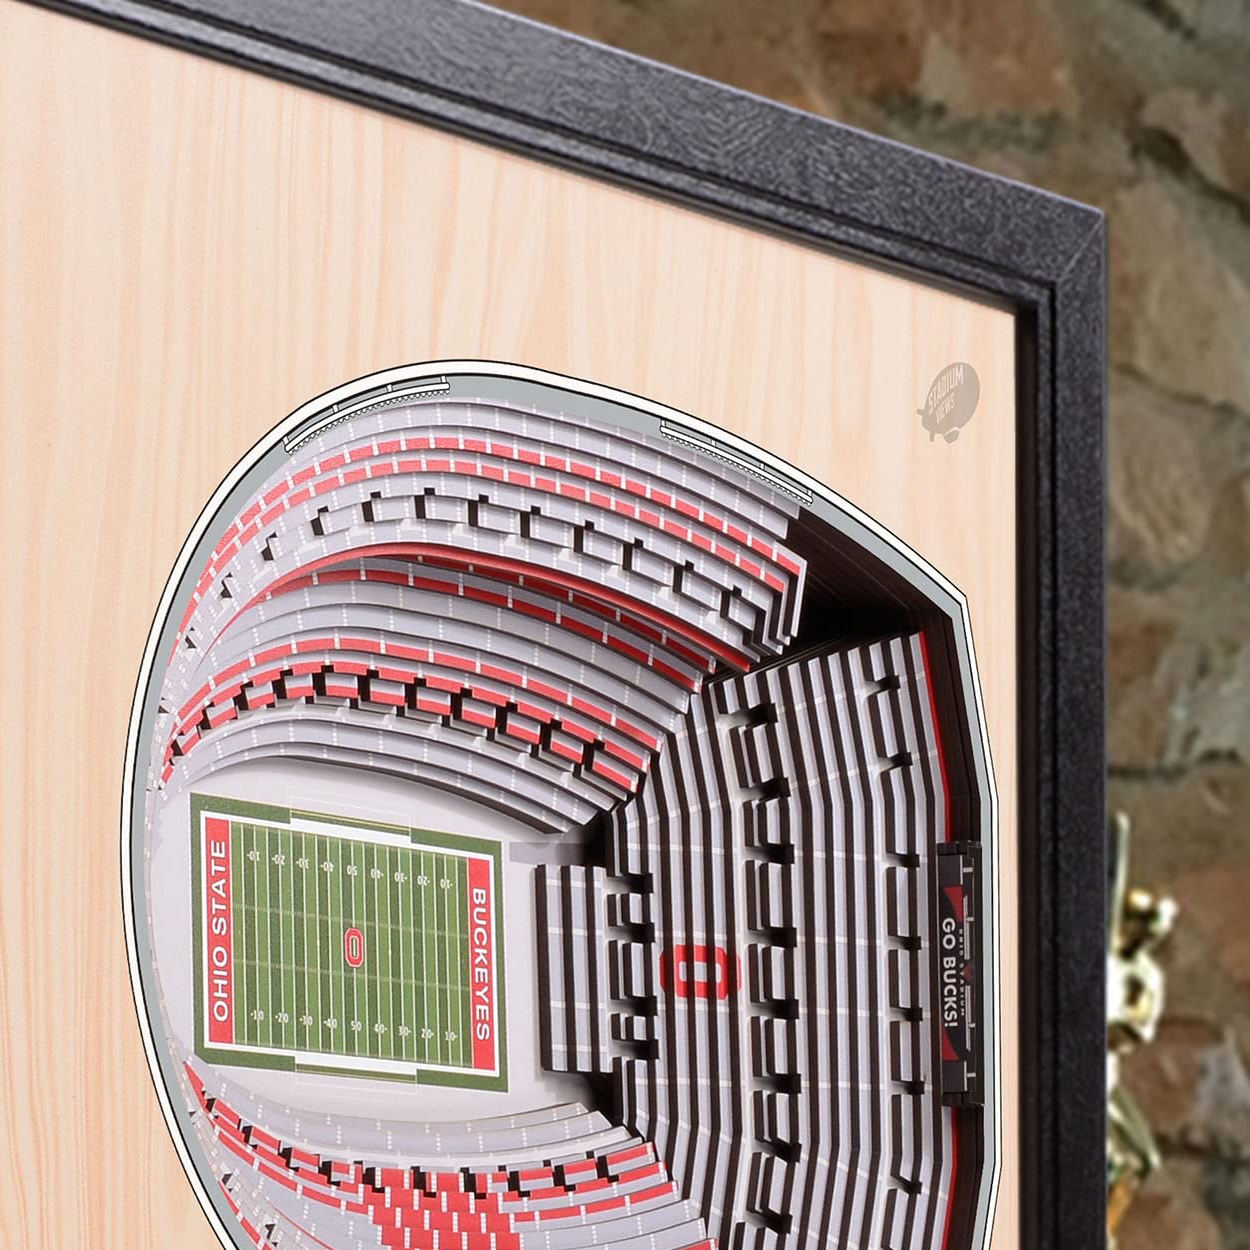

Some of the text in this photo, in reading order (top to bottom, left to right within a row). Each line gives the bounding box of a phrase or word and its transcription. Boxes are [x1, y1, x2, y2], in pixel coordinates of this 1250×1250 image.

[929, 364, 963, 415] STADIUM
[211, 840, 229, 1022] OHIO STATE
[472, 887, 490, 1041] BUCKEYES
[942, 917, 958, 1027] GO BUCKS!
